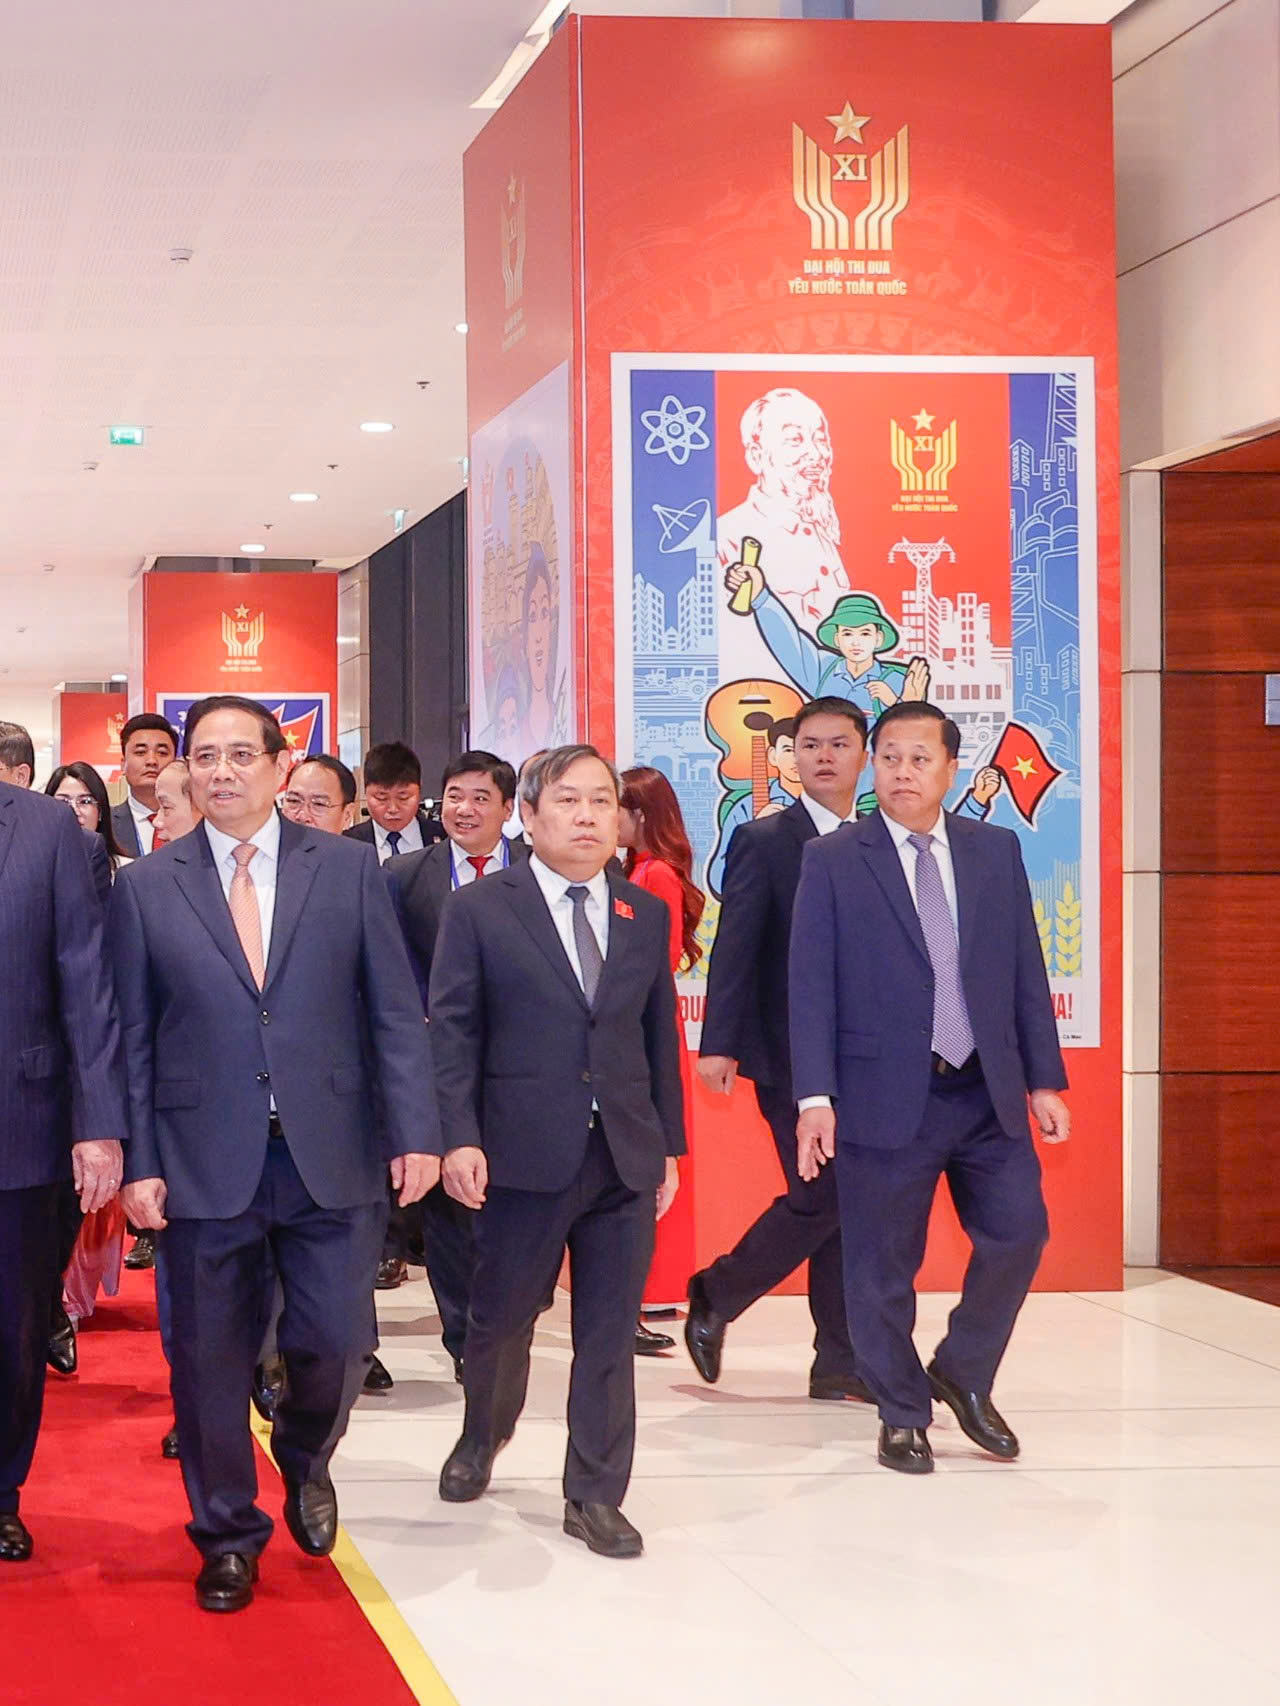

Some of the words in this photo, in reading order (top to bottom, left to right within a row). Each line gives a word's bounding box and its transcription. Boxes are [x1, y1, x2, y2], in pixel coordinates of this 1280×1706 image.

[832, 153, 868, 181] XI
[847, 260, 865, 275] THI
[867, 260, 891, 275] ĐUA
[788, 276, 810, 295] YÊU
[877, 279, 908, 296] QUỐC
[913, 435, 935, 452] XI
